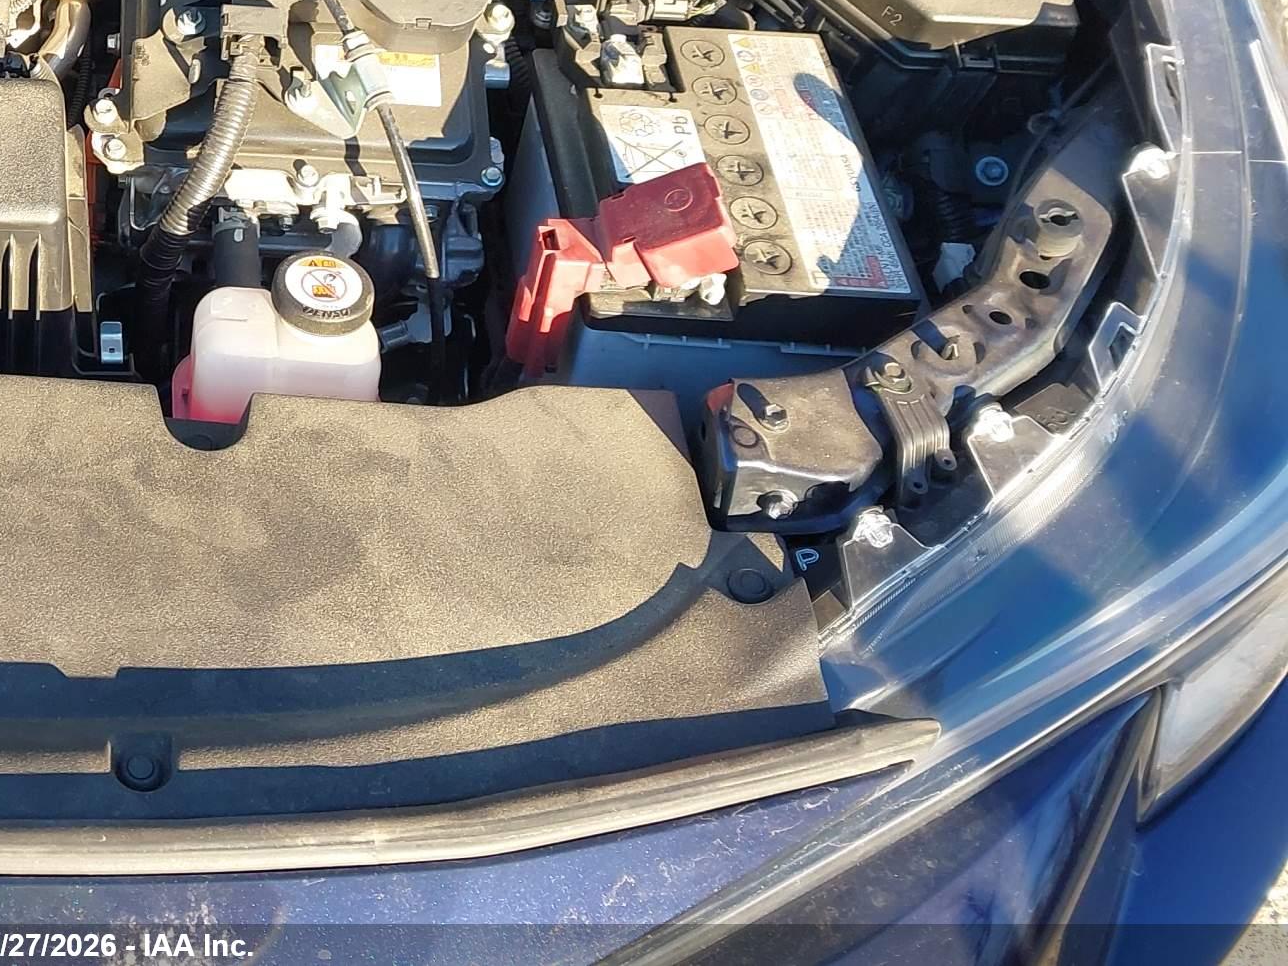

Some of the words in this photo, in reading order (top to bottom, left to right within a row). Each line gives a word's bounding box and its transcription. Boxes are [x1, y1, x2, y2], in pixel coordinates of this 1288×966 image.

[881, 5, 903, 26] F2
[671, 115, 692, 135] Pb
[302, 306, 352, 318] DENSO
